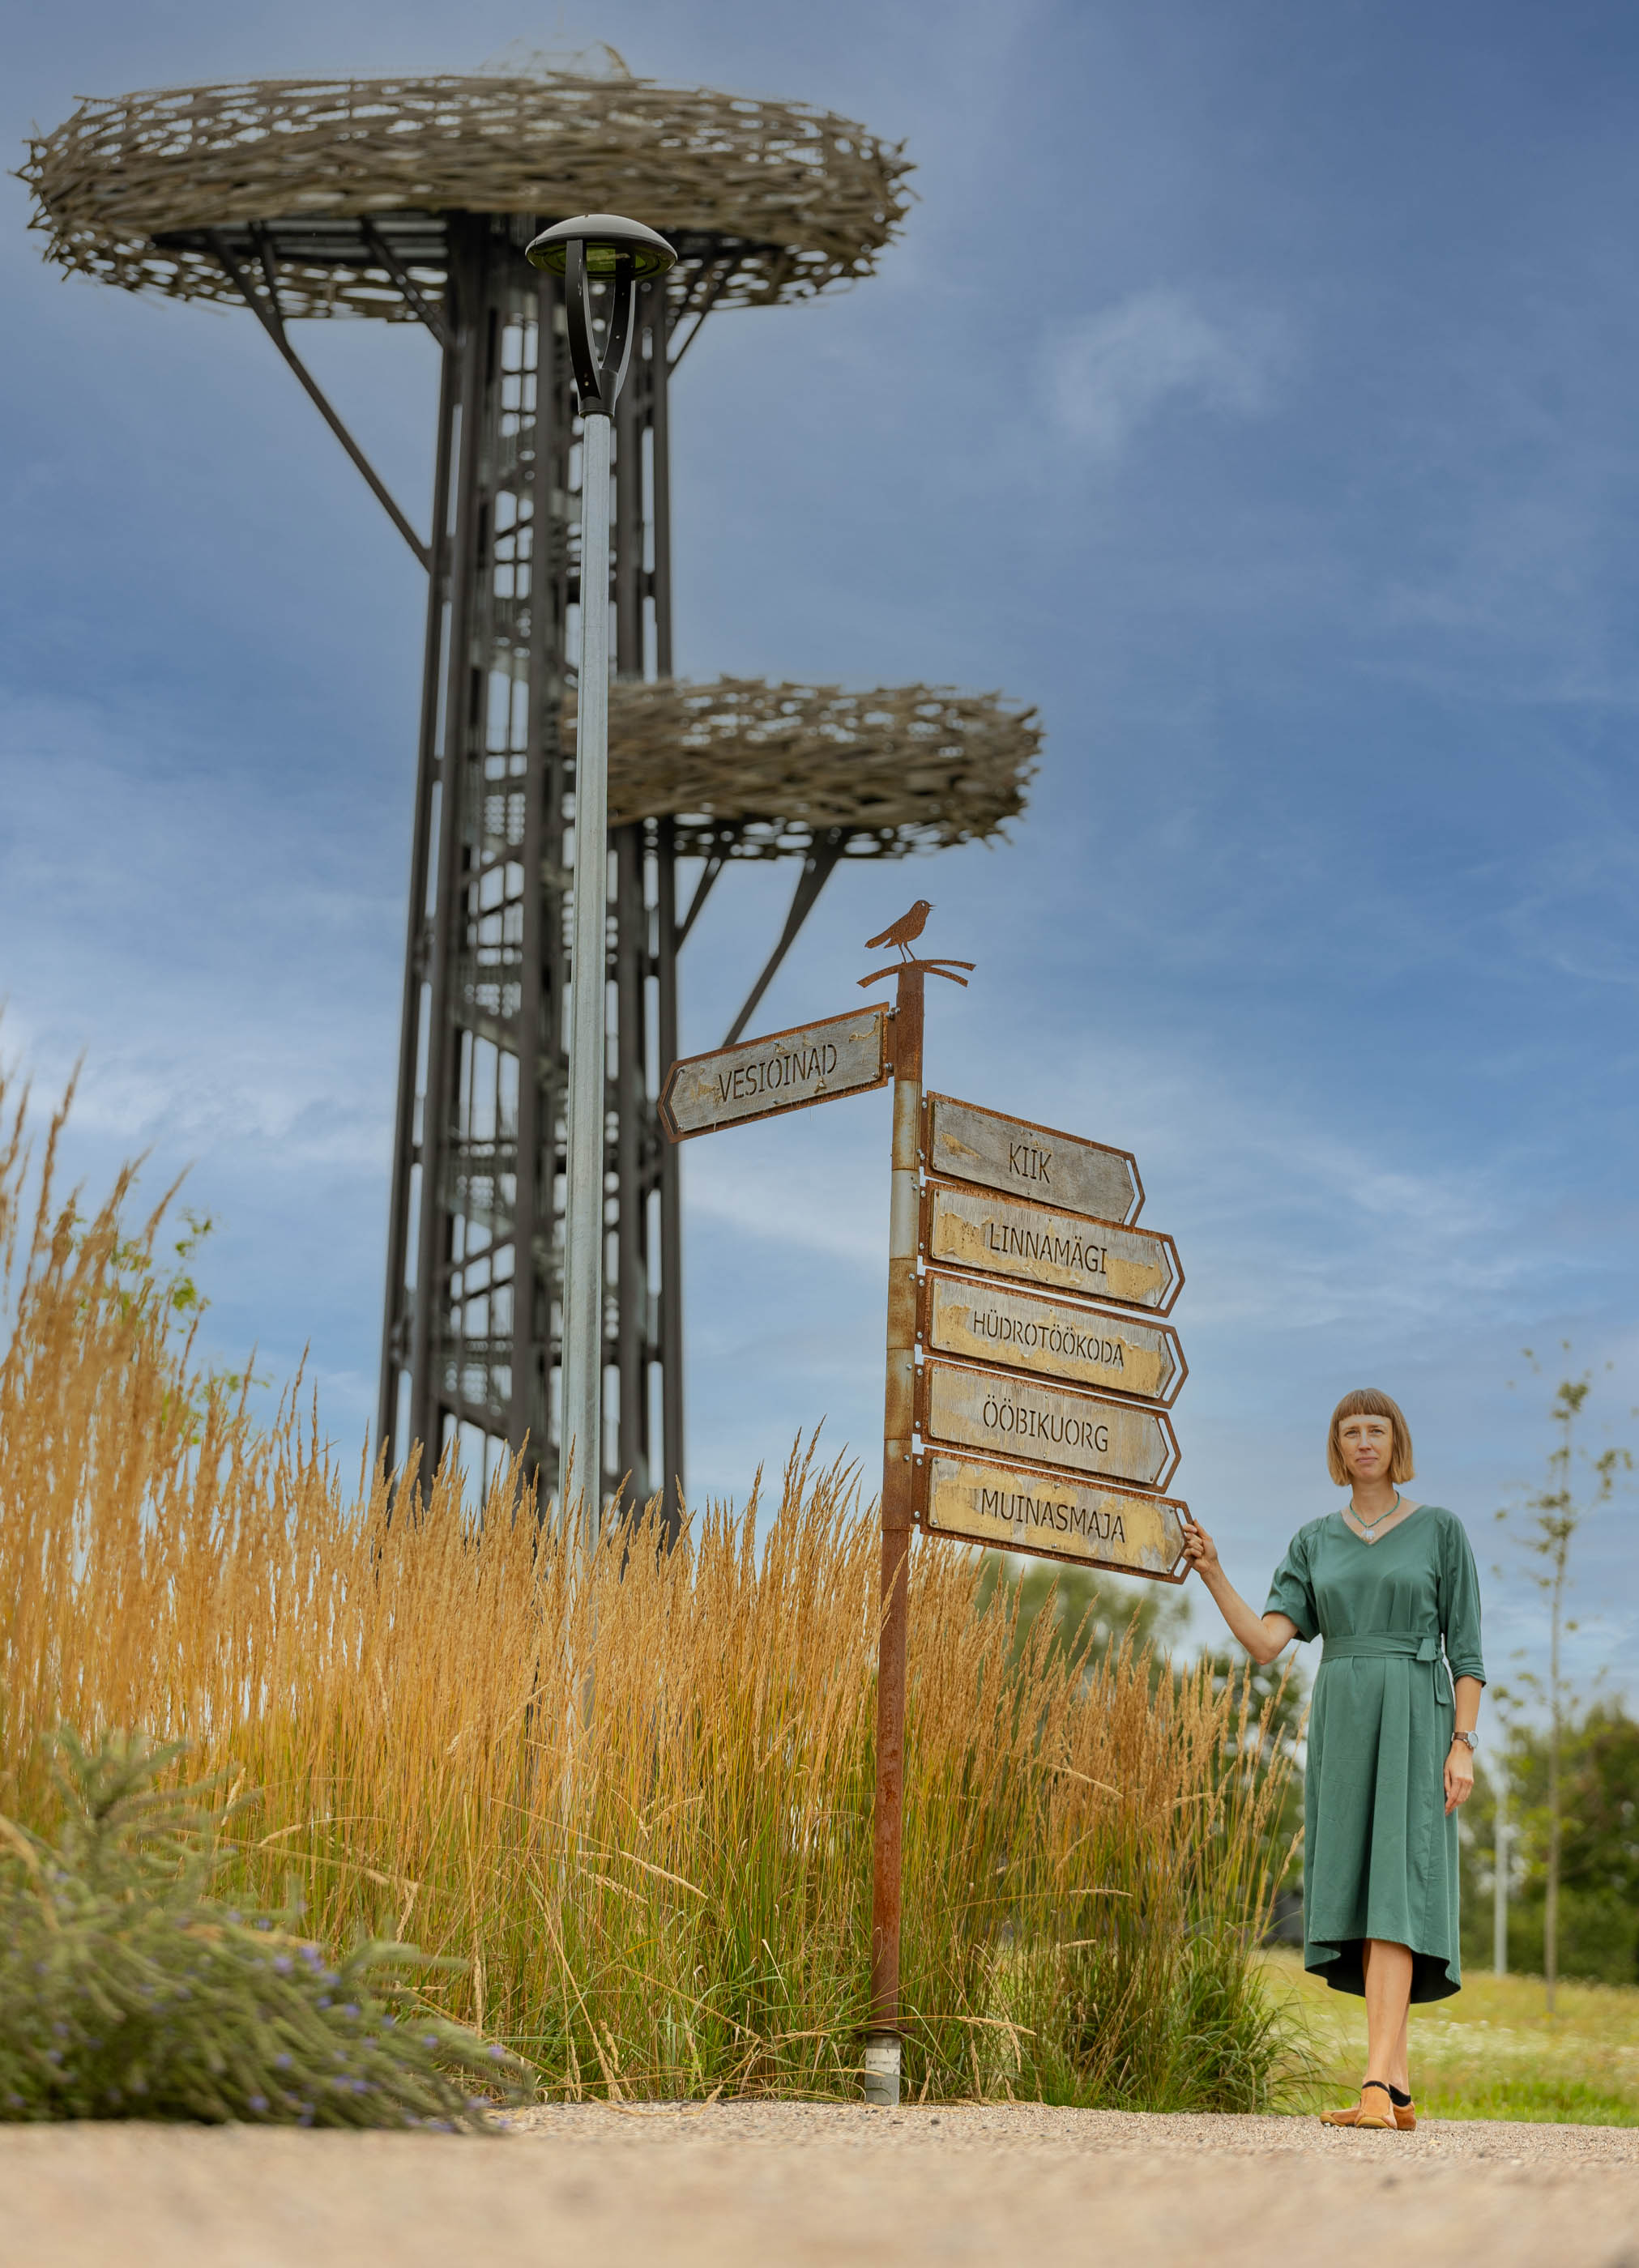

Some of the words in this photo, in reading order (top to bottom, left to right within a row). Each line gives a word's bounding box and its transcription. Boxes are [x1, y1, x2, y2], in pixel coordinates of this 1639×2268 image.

[1009, 1142, 1052, 1183] KIIK
[989, 1222, 1108, 1274] LINNAMÄGI
[973, 1308, 1125, 1367] HÜDROTÖÖKODA
[983, 1393, 1108, 1452] ÖÖBIKUORG
[980, 1488, 1125, 1544] MUINASMAJA
